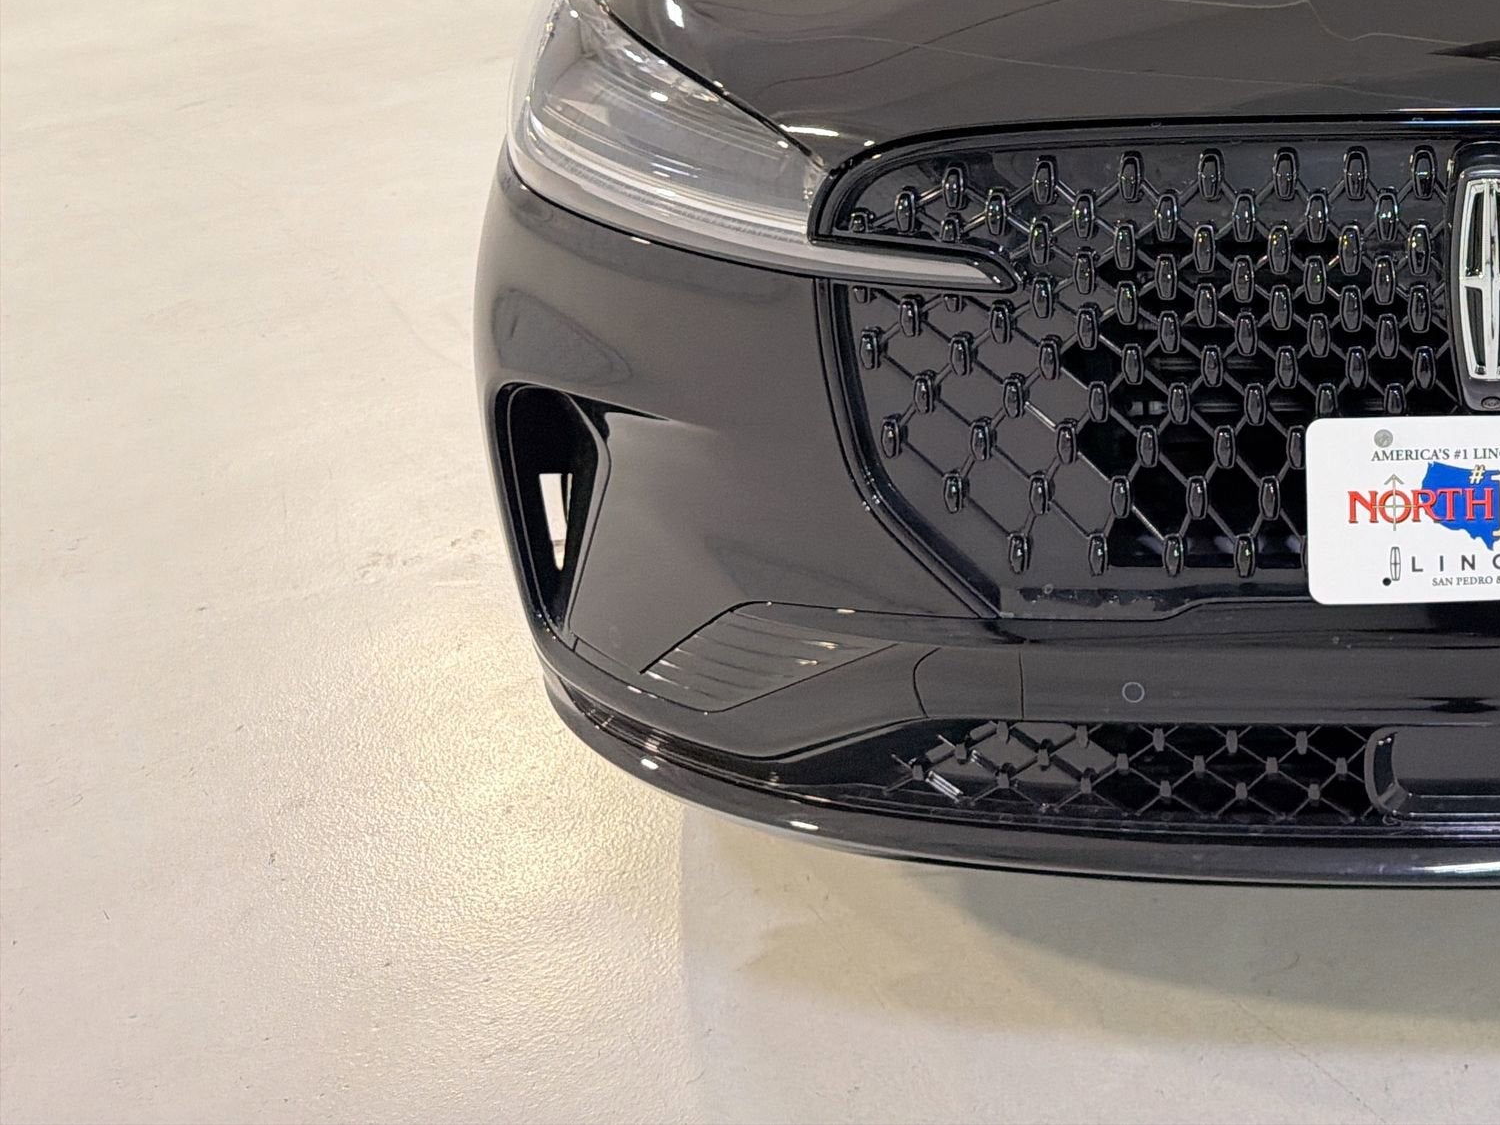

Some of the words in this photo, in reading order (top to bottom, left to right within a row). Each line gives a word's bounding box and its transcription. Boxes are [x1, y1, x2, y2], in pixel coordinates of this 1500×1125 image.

[1371, 448, 1450, 462] AMERICA'S
[1453, 447, 1469, 461] #1
[1347, 487, 1495, 524] NORTH
[1432, 576, 1454, 587] SAN
[1456, 576, 1494, 586] PEDRO
